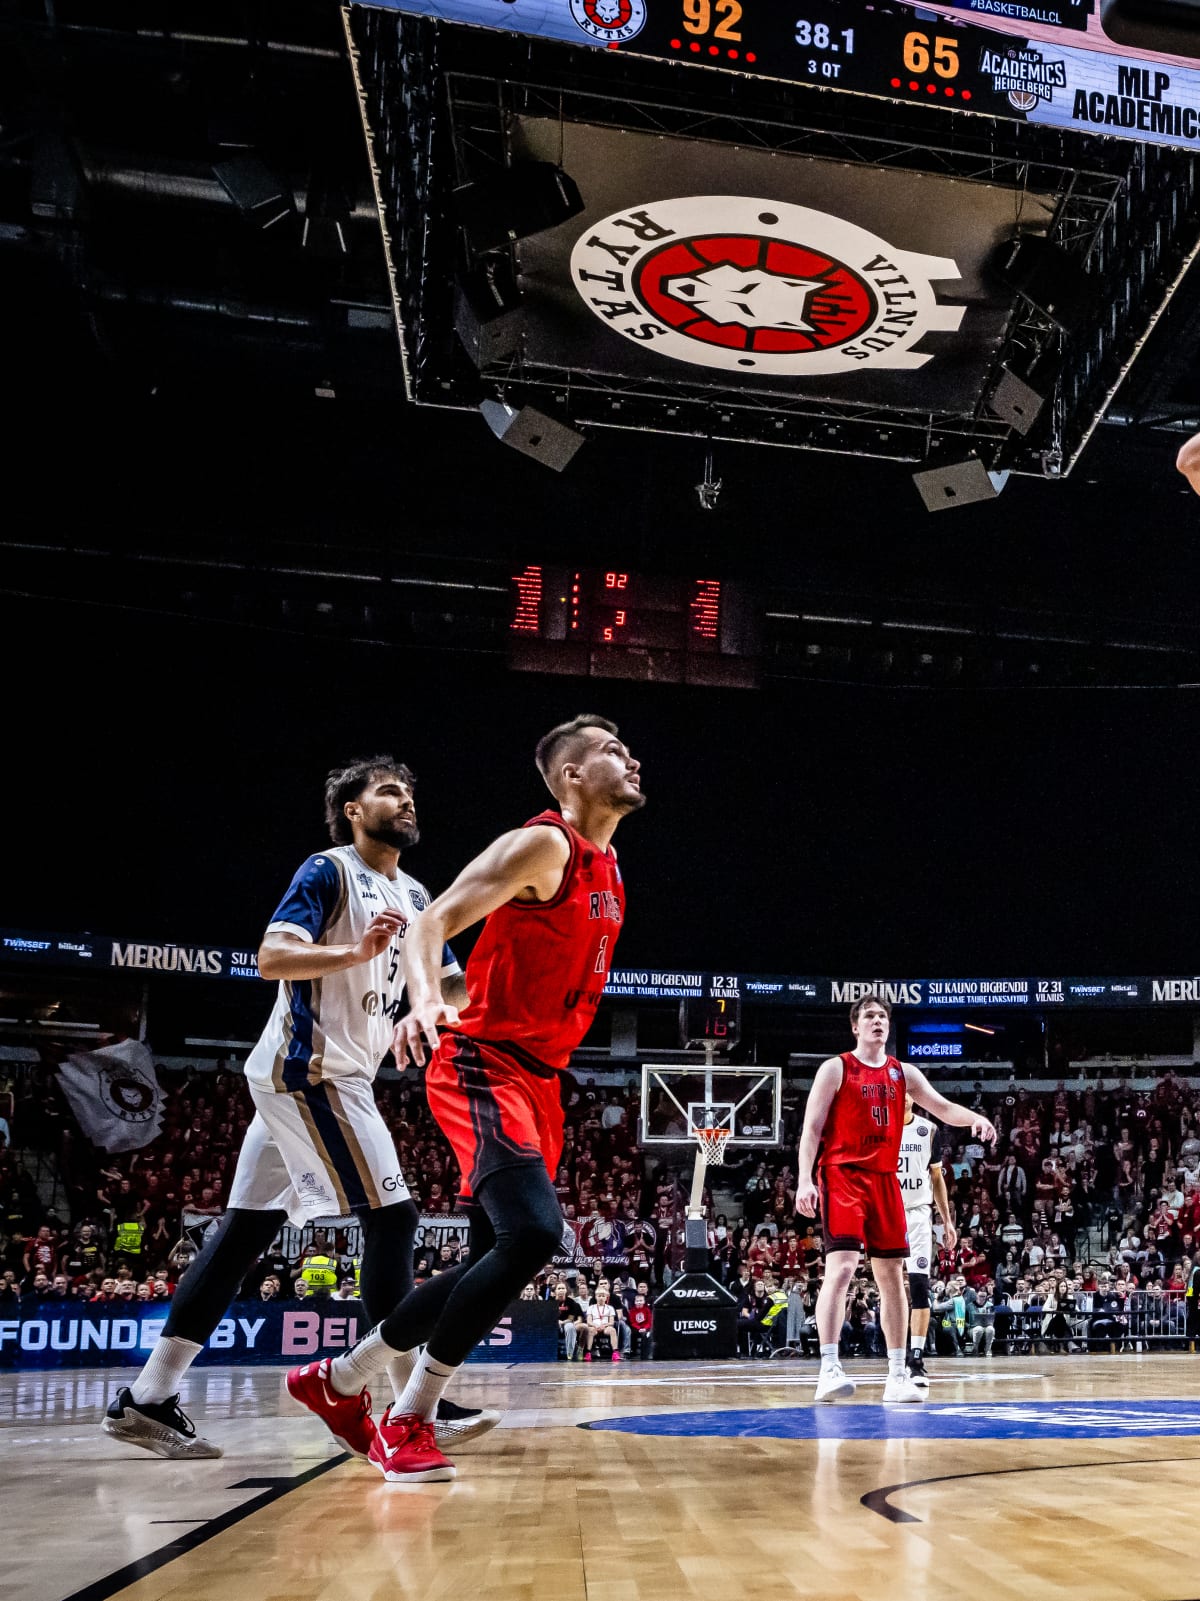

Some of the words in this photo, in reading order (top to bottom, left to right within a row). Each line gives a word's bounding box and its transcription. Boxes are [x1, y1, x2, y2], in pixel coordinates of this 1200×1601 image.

[682, 0, 743, 42] 92
[970, 0, 1062, 24] #BASKETBALLCL
[581, 18, 634, 39] RYTAS
[795, 20, 855, 54] 38.1
[903, 31, 960, 78] 65
[1018, 51, 1040, 62] MLP
[808, 60, 817, 73] 3
[822, 62, 841, 78] QT
[981, 50, 1065, 86] ACADEMICS
[994, 76, 1051, 99] HEIDELBERG
[1117, 65, 1170, 102] MLP
[577, 210, 676, 342] RYTAS
[841, 253, 919, 360] VILNIUS
[606, 573, 627, 588] 92
[616, 611, 625, 625] 3
[111, 943, 223, 974] MERŪNAS
[231, 951, 248, 965] SU
[613, 972, 648, 985] KAUNO
[651, 973, 702, 987] BIGBENDU
[712, 976, 724, 988] 12
[726, 977, 738, 989] 31
[928, 982, 942, 994] SU
[945, 982, 978, 993] KAUNO
[980, 981, 1028, 994] BIGBENDU
[1038, 982, 1049, 993] 12
[1050, 981, 1062, 992] 31
[710, 988, 740, 998] VILNIUS
[1035, 992, 1064, 1002] VILNIUS
[871, 1105, 890, 1126] 41
[0, 1319, 166, 1350] FOUNDE
[209, 1318, 266, 1348] BY
[673, 1320, 717, 1332] UTENOS
